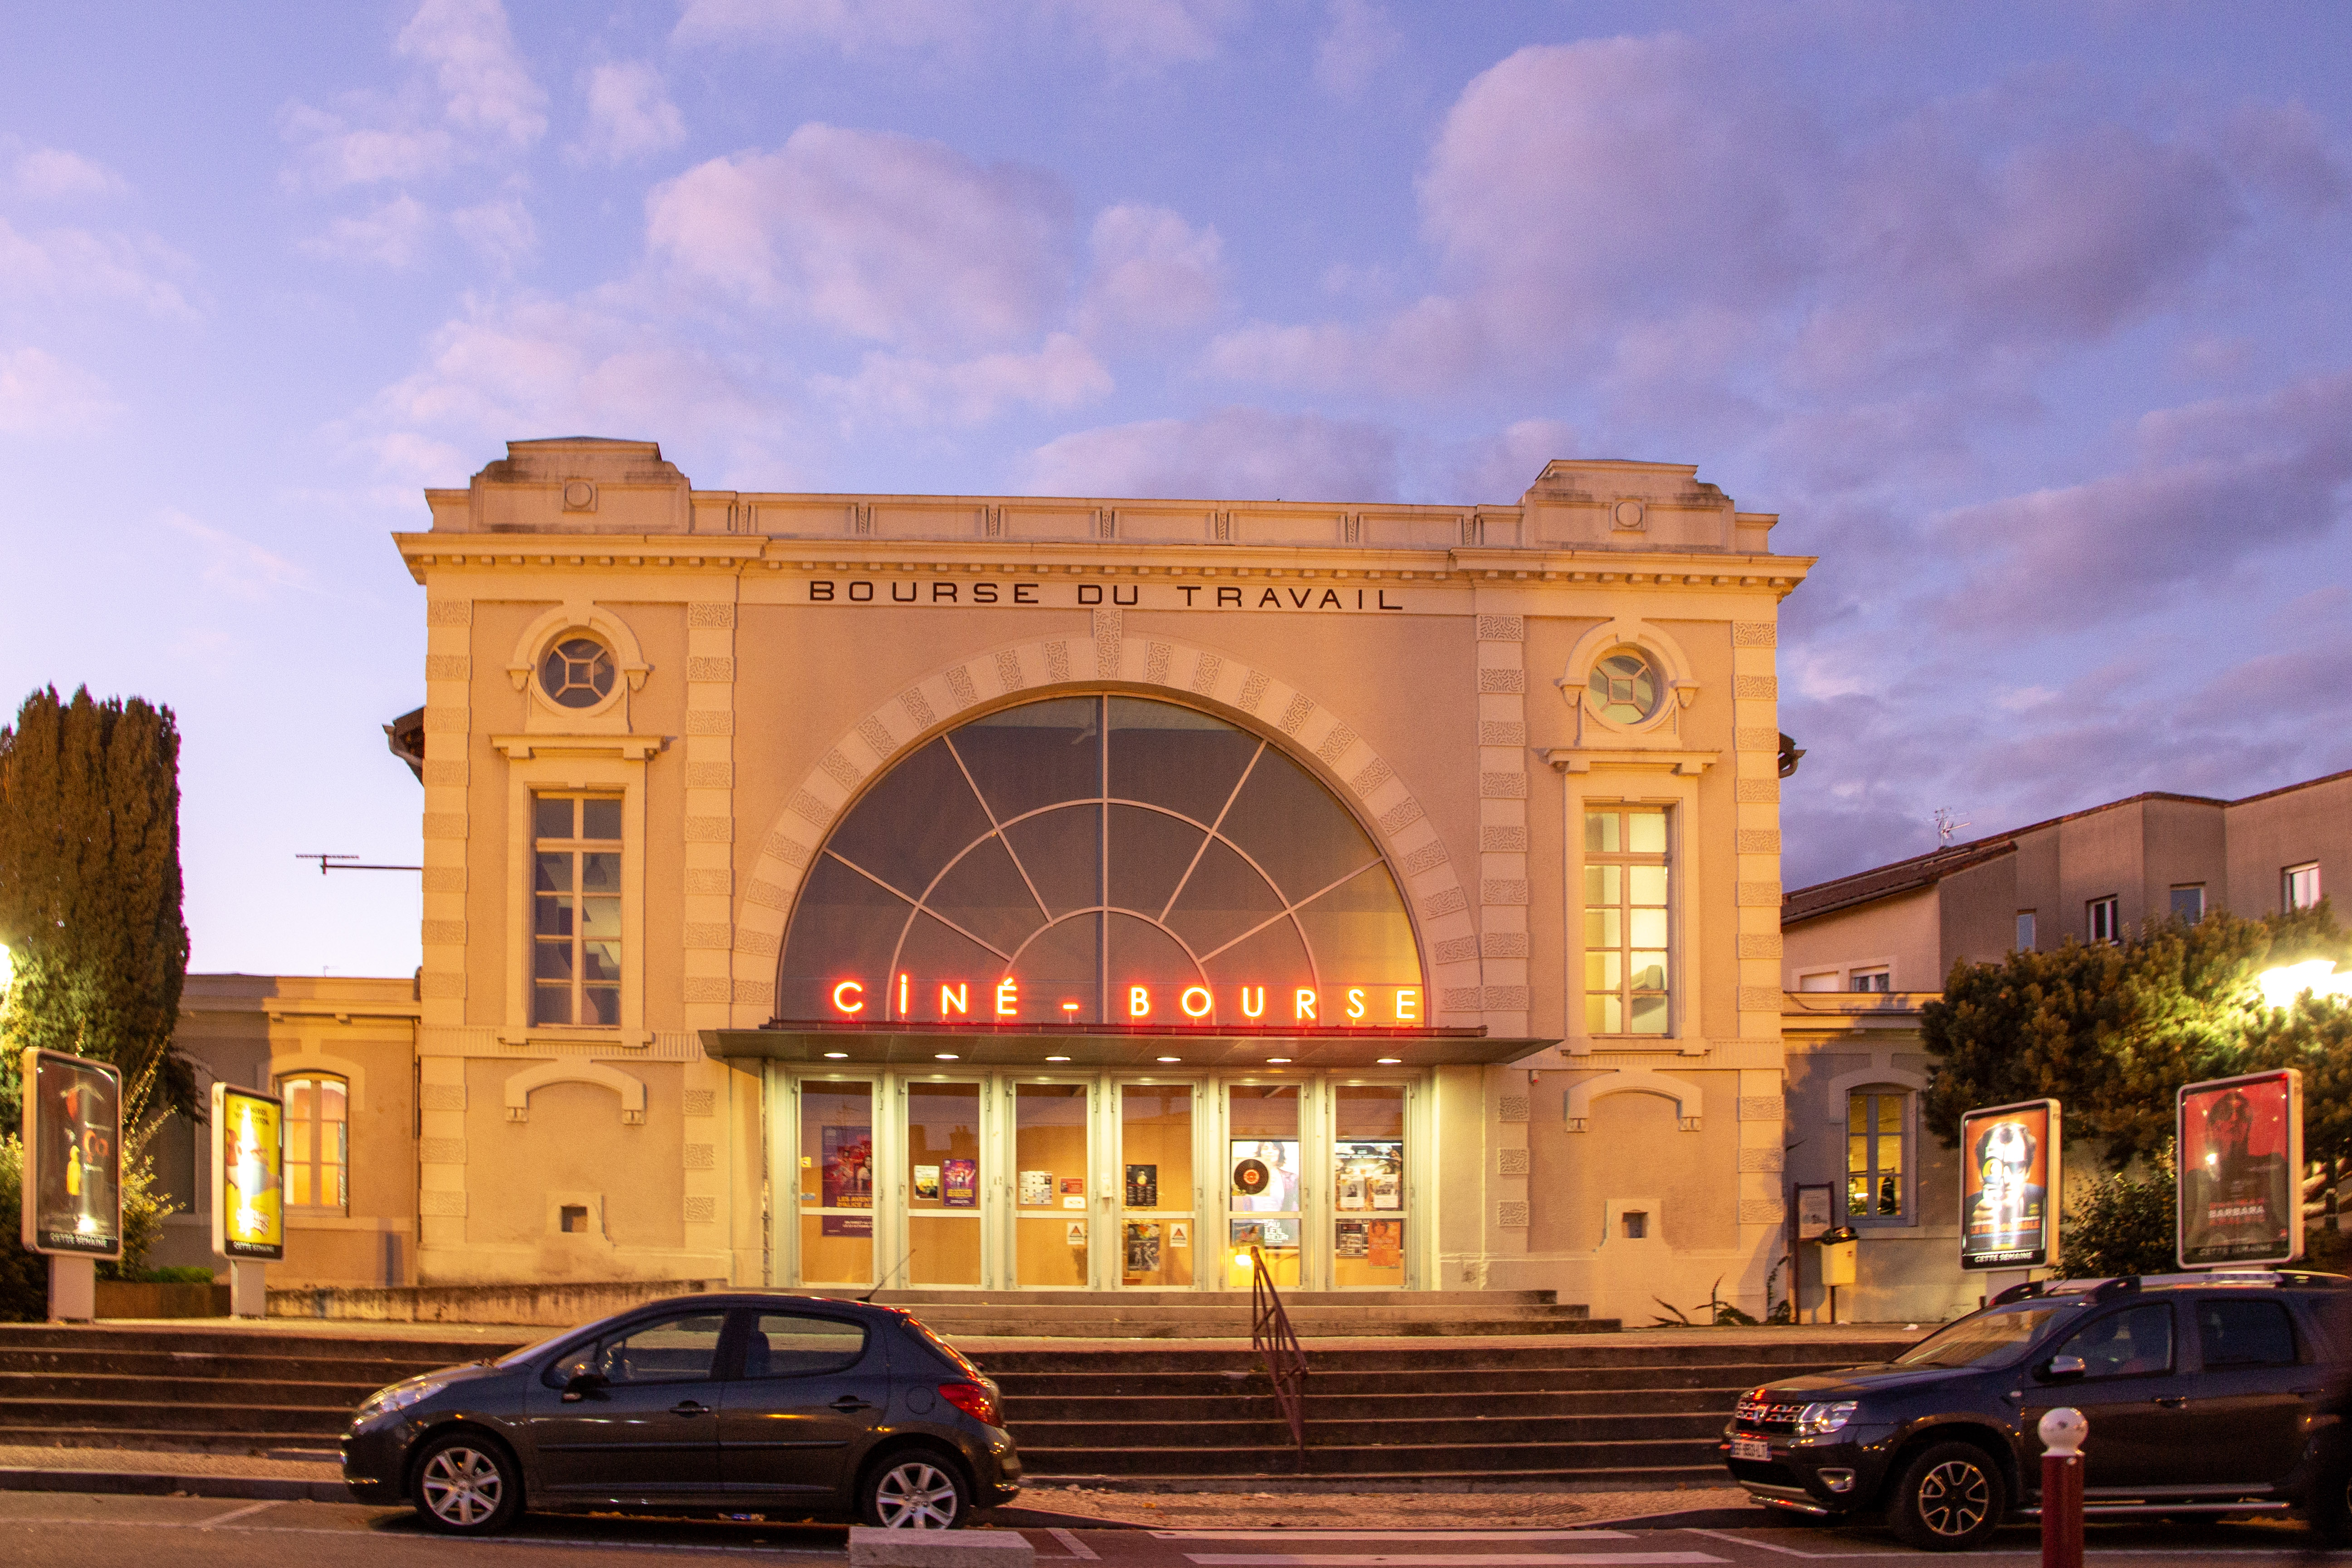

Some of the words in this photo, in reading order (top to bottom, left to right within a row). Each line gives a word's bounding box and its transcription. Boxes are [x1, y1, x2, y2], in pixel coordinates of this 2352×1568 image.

[810, 581, 1039, 604] BOURSE
[1078, 584, 1138, 605] DU
[1176, 586, 1403, 610] TRAVAIL
[1128, 985, 1417, 1023] BOURSE
[2208, 1205, 2265, 1219] BARBARA
[50, 1232, 75, 1245] CETTE
[75, 1235, 108, 1248] SEMAINE
[1974, 1254, 1999, 1263] CETTE
[1999, 1251, 2034, 1261] SEMAINE
